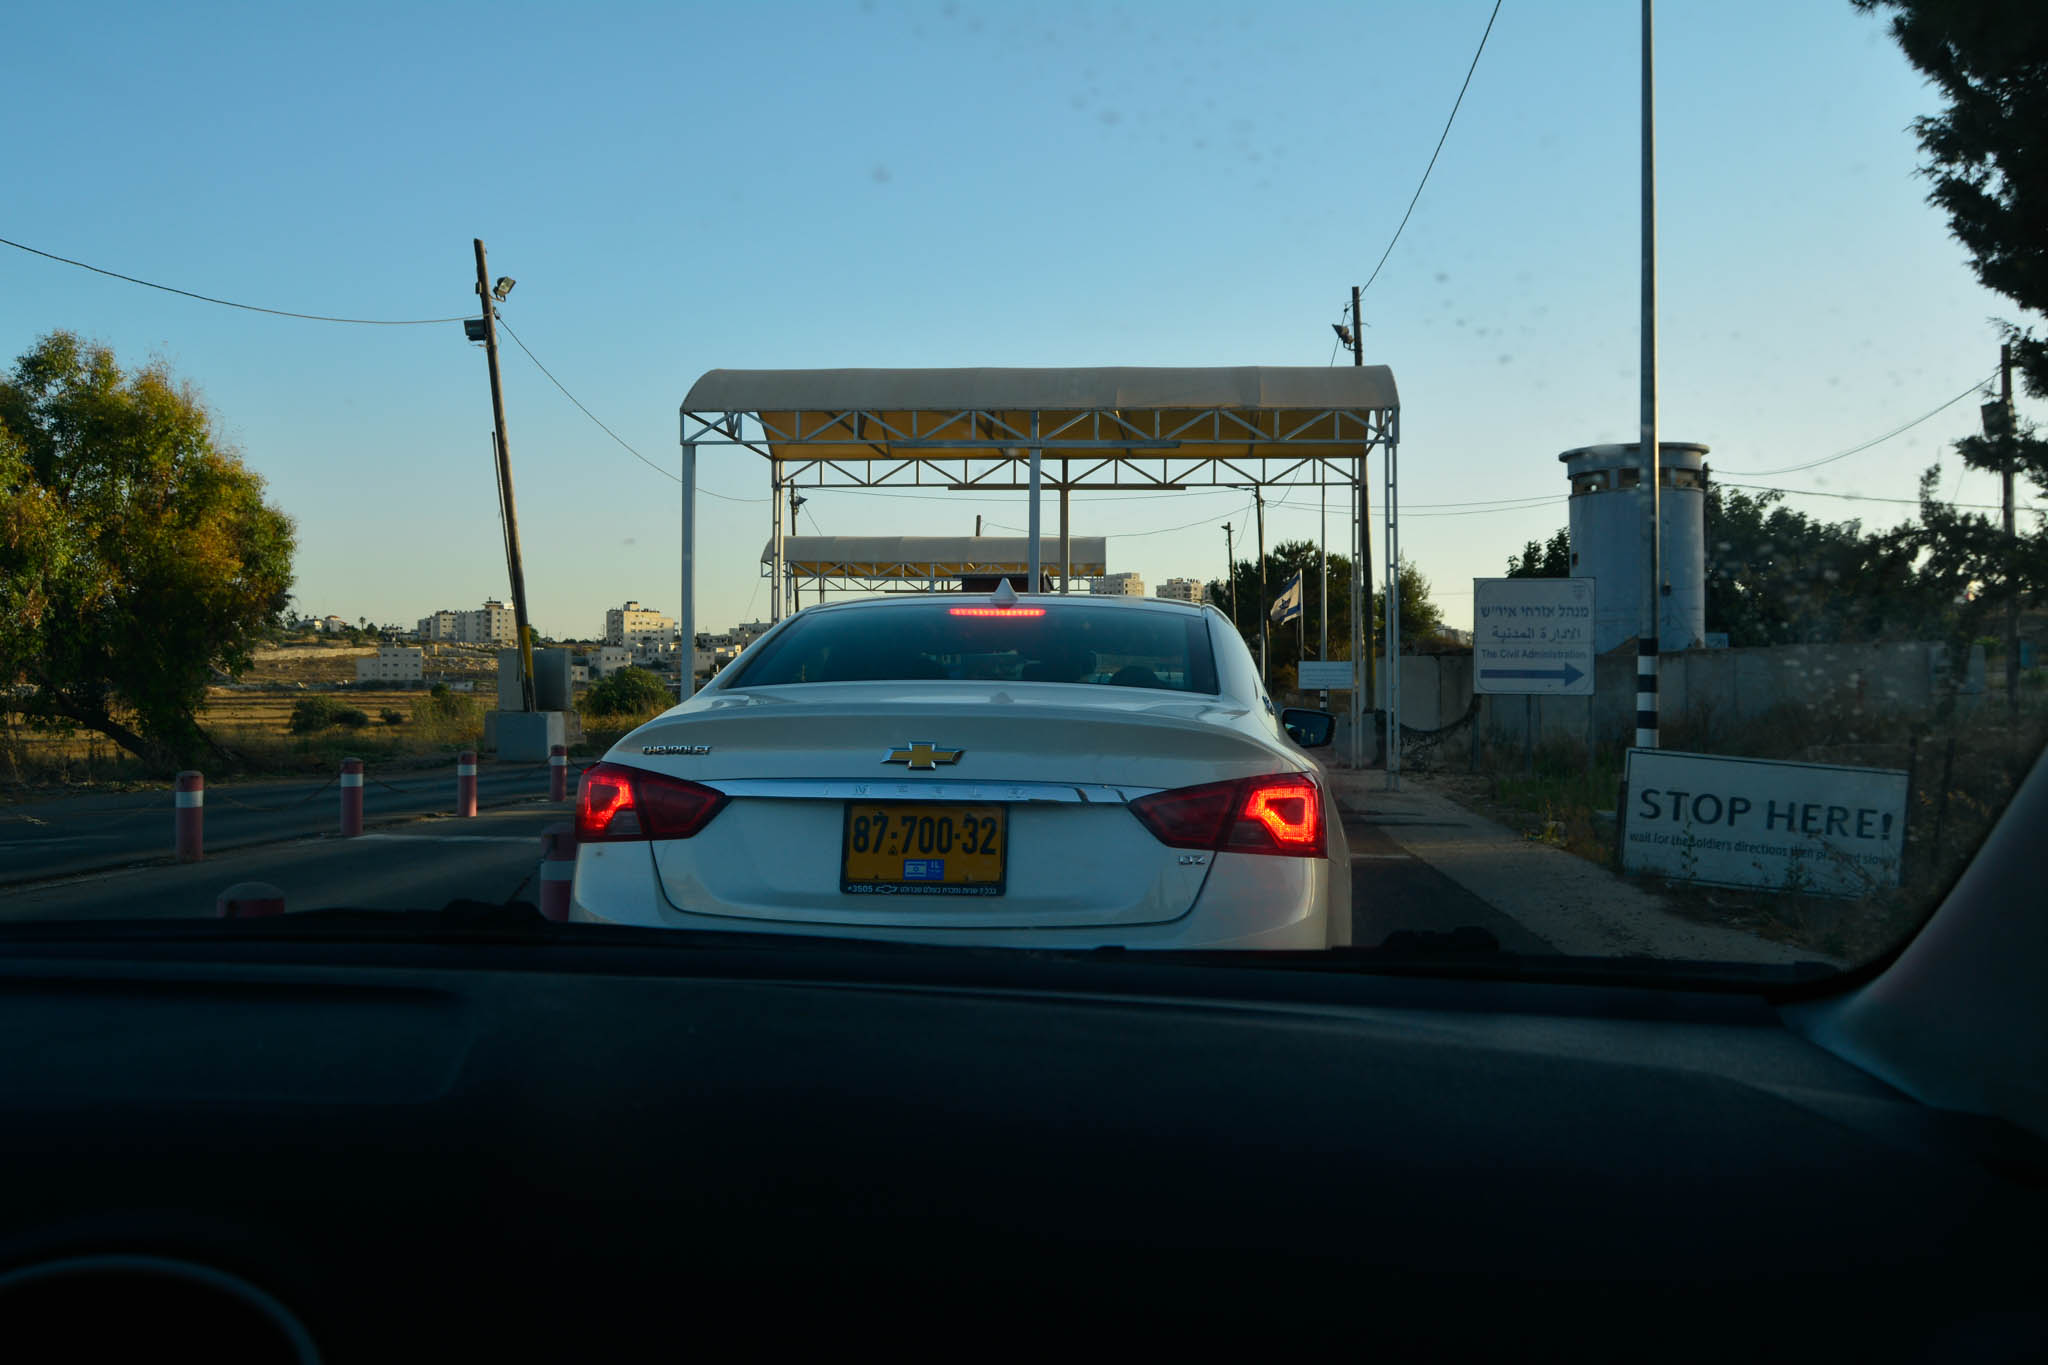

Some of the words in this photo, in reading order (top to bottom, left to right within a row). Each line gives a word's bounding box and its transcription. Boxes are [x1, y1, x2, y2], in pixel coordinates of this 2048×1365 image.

[1480, 648, 1497, 658] The
[1499, 648, 1520, 659] Civil
[1521, 648, 1587, 660] Administration
[642, 745, 711, 755] CHEVROLET
[1639, 788, 1752, 827] STOP
[1765, 799, 1893, 841] HERE!
[1630, 832, 1651, 843] wait
[1653, 832, 1672, 845] for
[1734, 840, 1788, 857] directions
